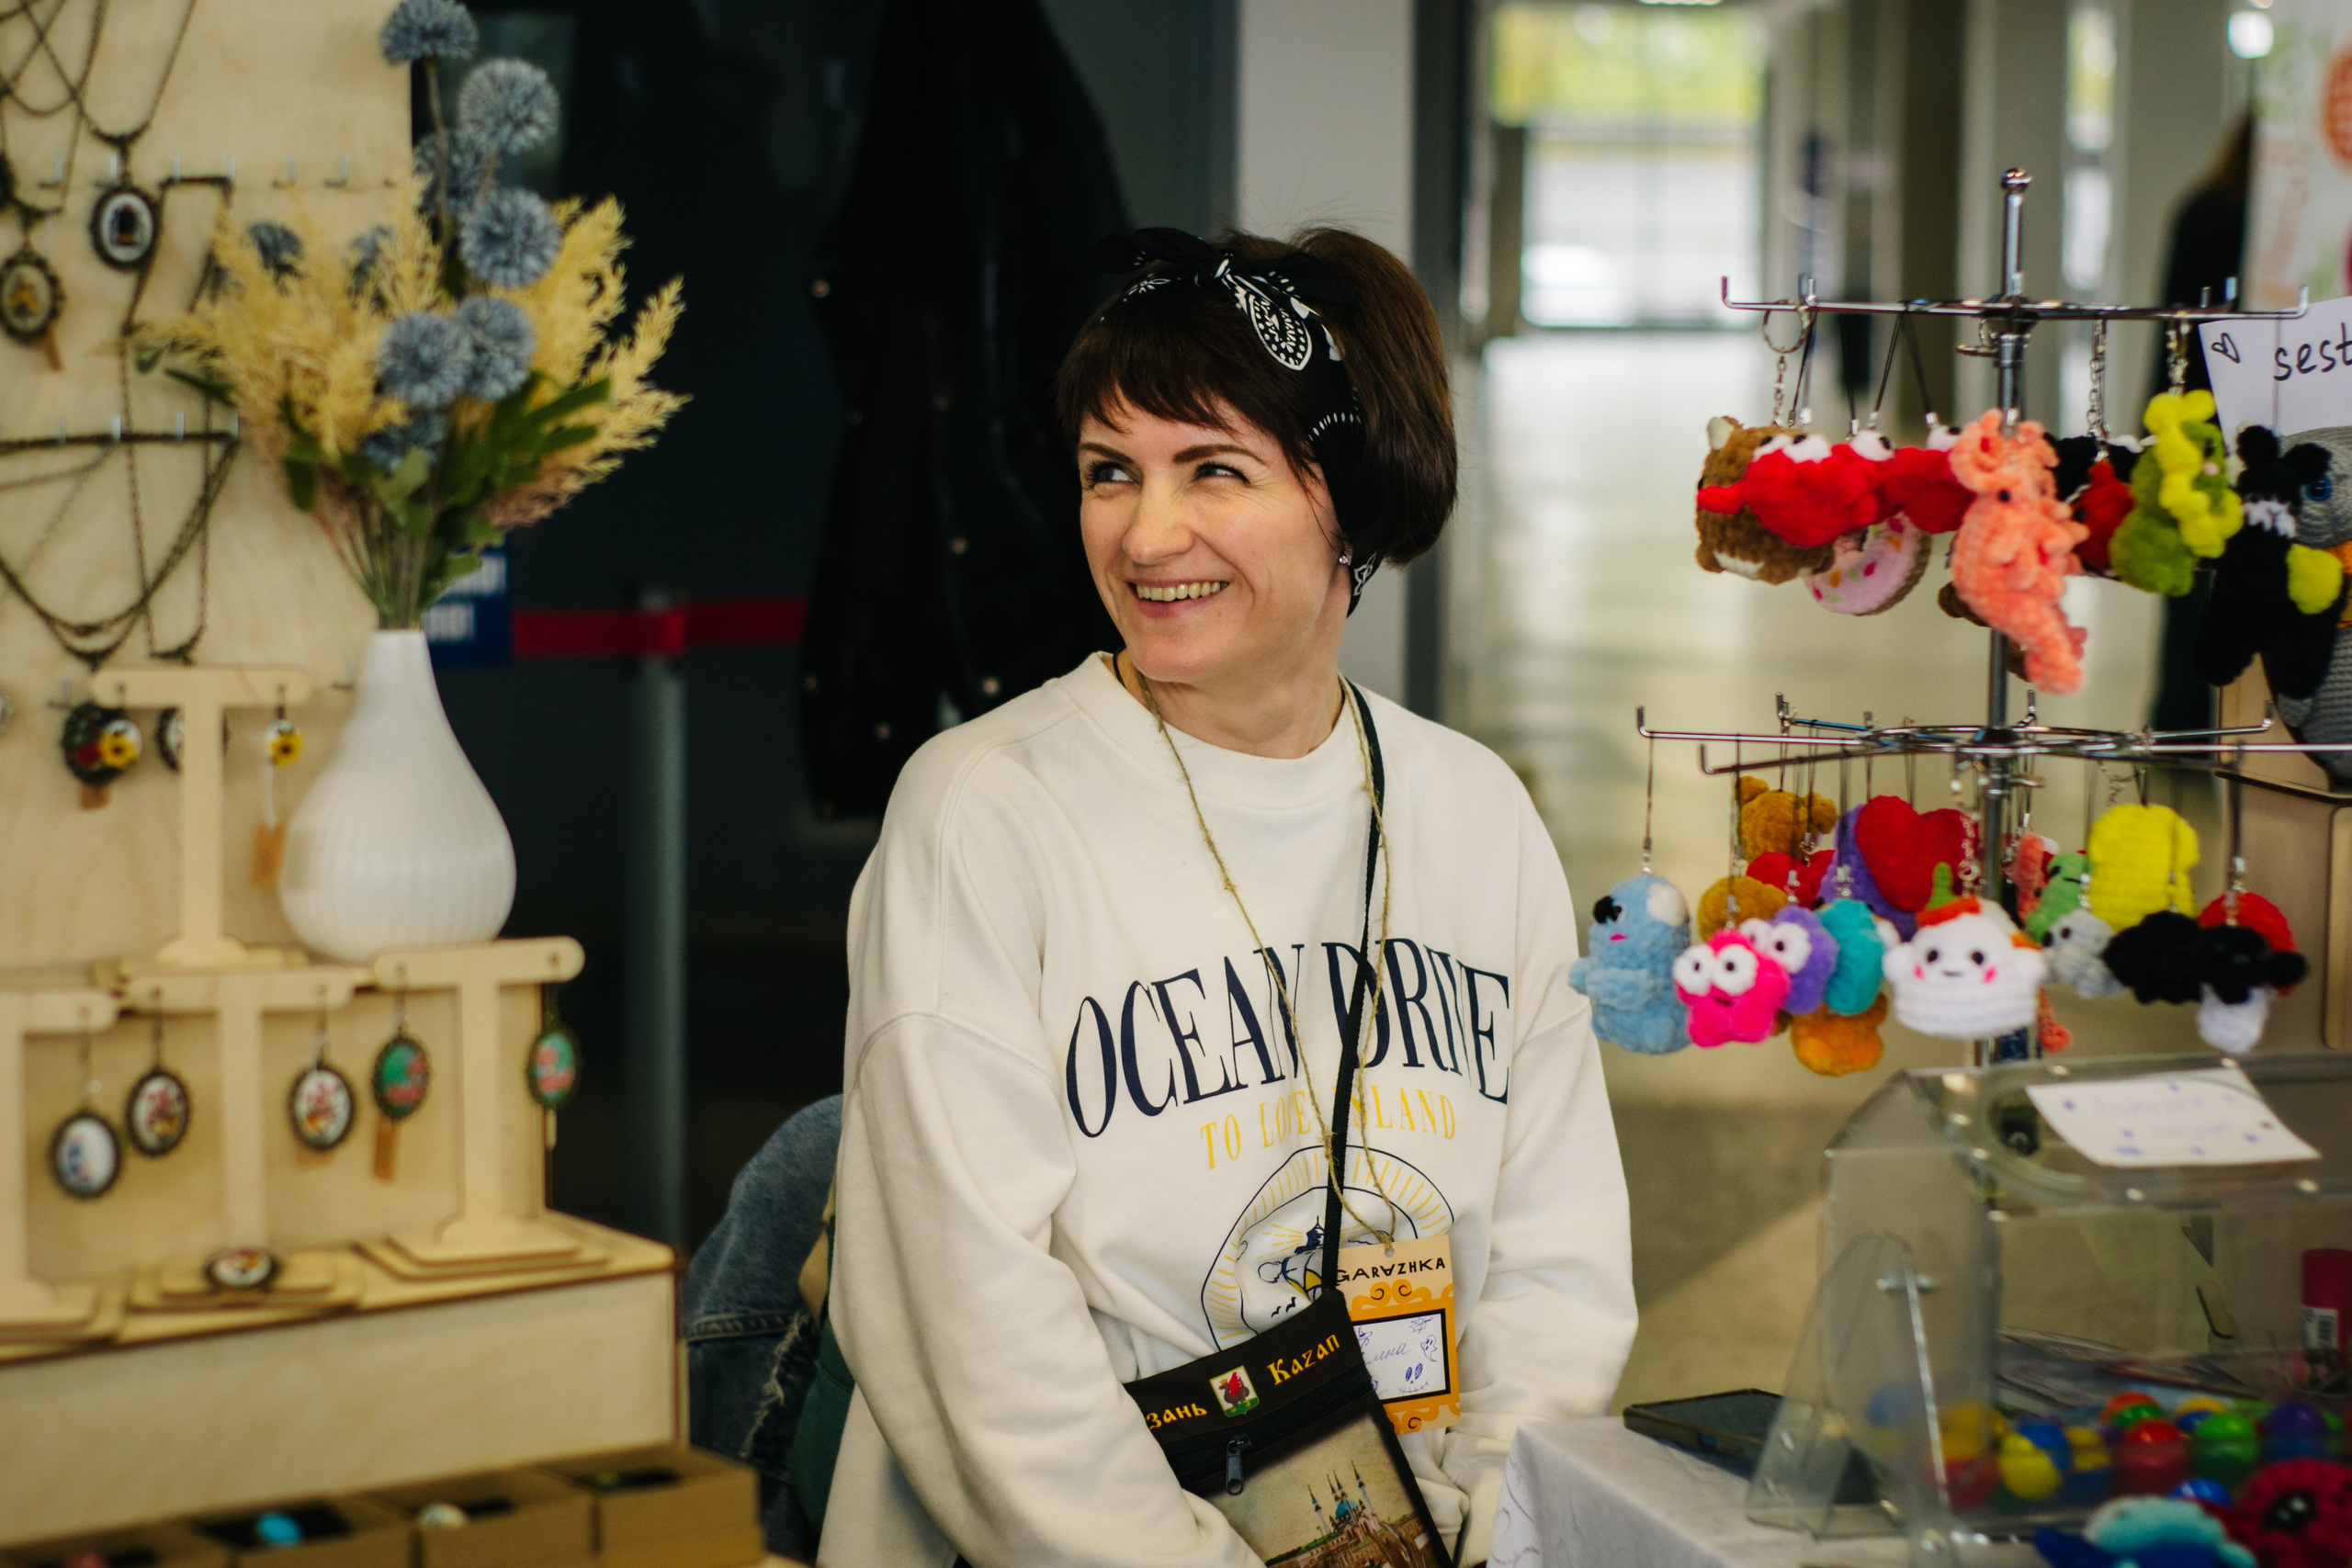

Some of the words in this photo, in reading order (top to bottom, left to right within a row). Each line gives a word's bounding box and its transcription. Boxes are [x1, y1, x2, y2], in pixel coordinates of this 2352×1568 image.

[1065, 943, 1306, 1138] OCEAN
[1321, 938, 1510, 1105] DRIVE
[1200, 1113, 1241, 1170] TO
[1332, 1084, 1456, 1140] SLAND
[1266, 1333, 1340, 1386] Kazan
[1146, 1402, 1208, 1430] зань
